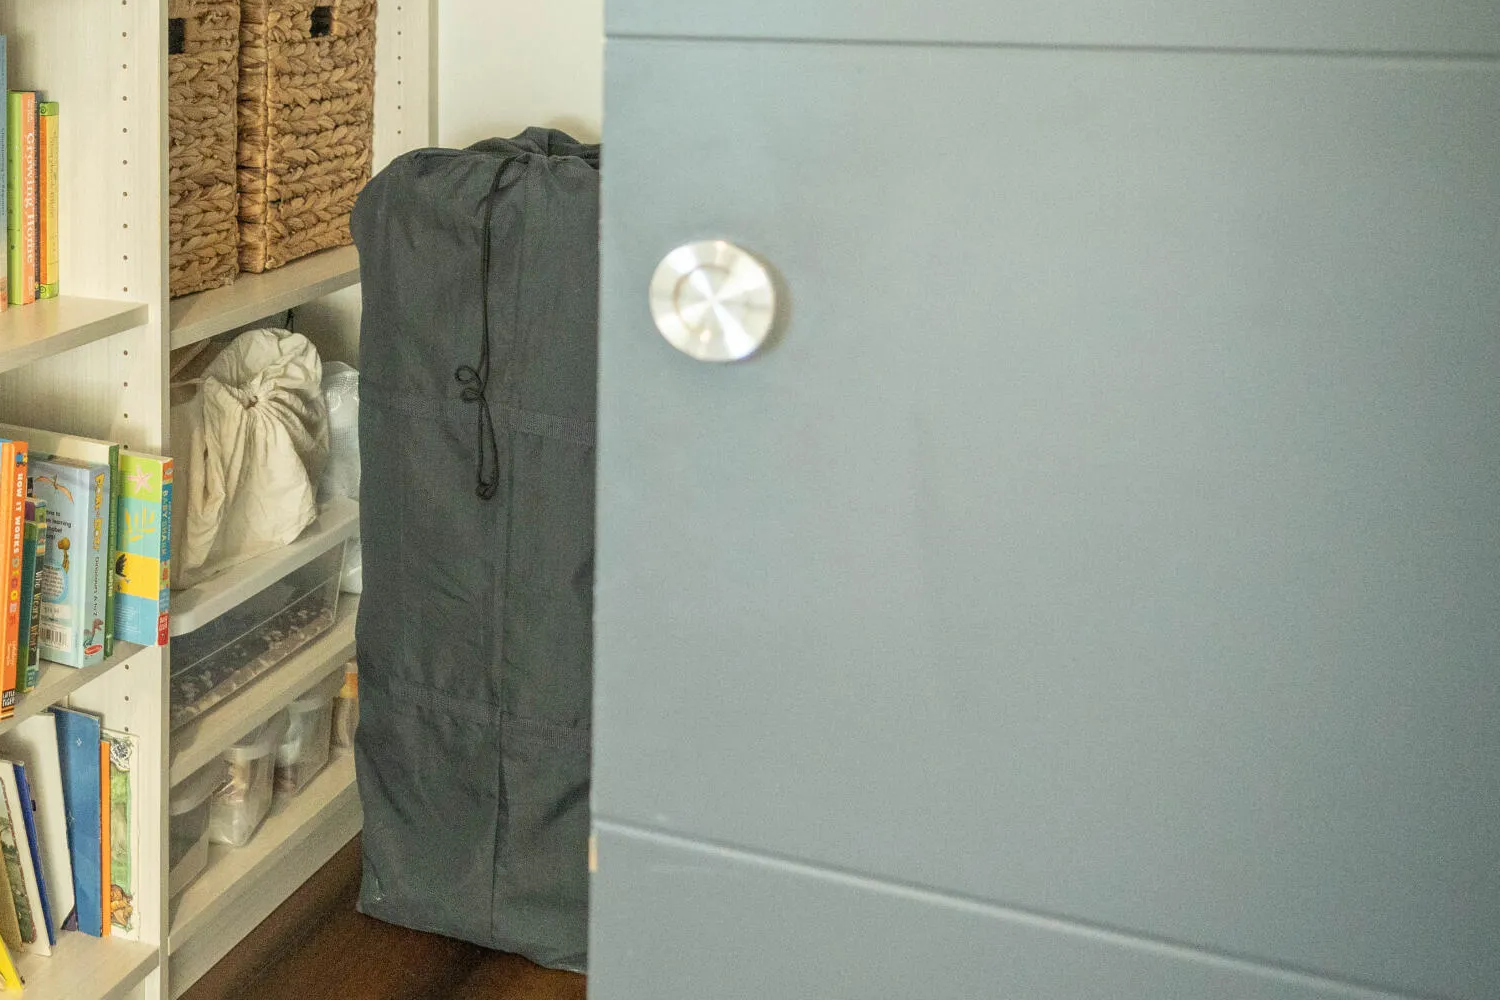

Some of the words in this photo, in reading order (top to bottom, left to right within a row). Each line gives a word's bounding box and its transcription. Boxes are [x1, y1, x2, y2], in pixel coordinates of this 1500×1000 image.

[25, 132, 35, 209] Growing
[26, 213, 35, 264] Home
[16, 473, 24, 498] HOW
[15, 501, 22, 512] IT
[13, 515, 21, 554] WORKS
[34, 569, 43, 589] Who
[32, 592, 42, 620] Wears
[29, 624, 39, 652] What?
[2, 690, 16, 699] LITTLE
[2, 697, 15, 707] TIGER
